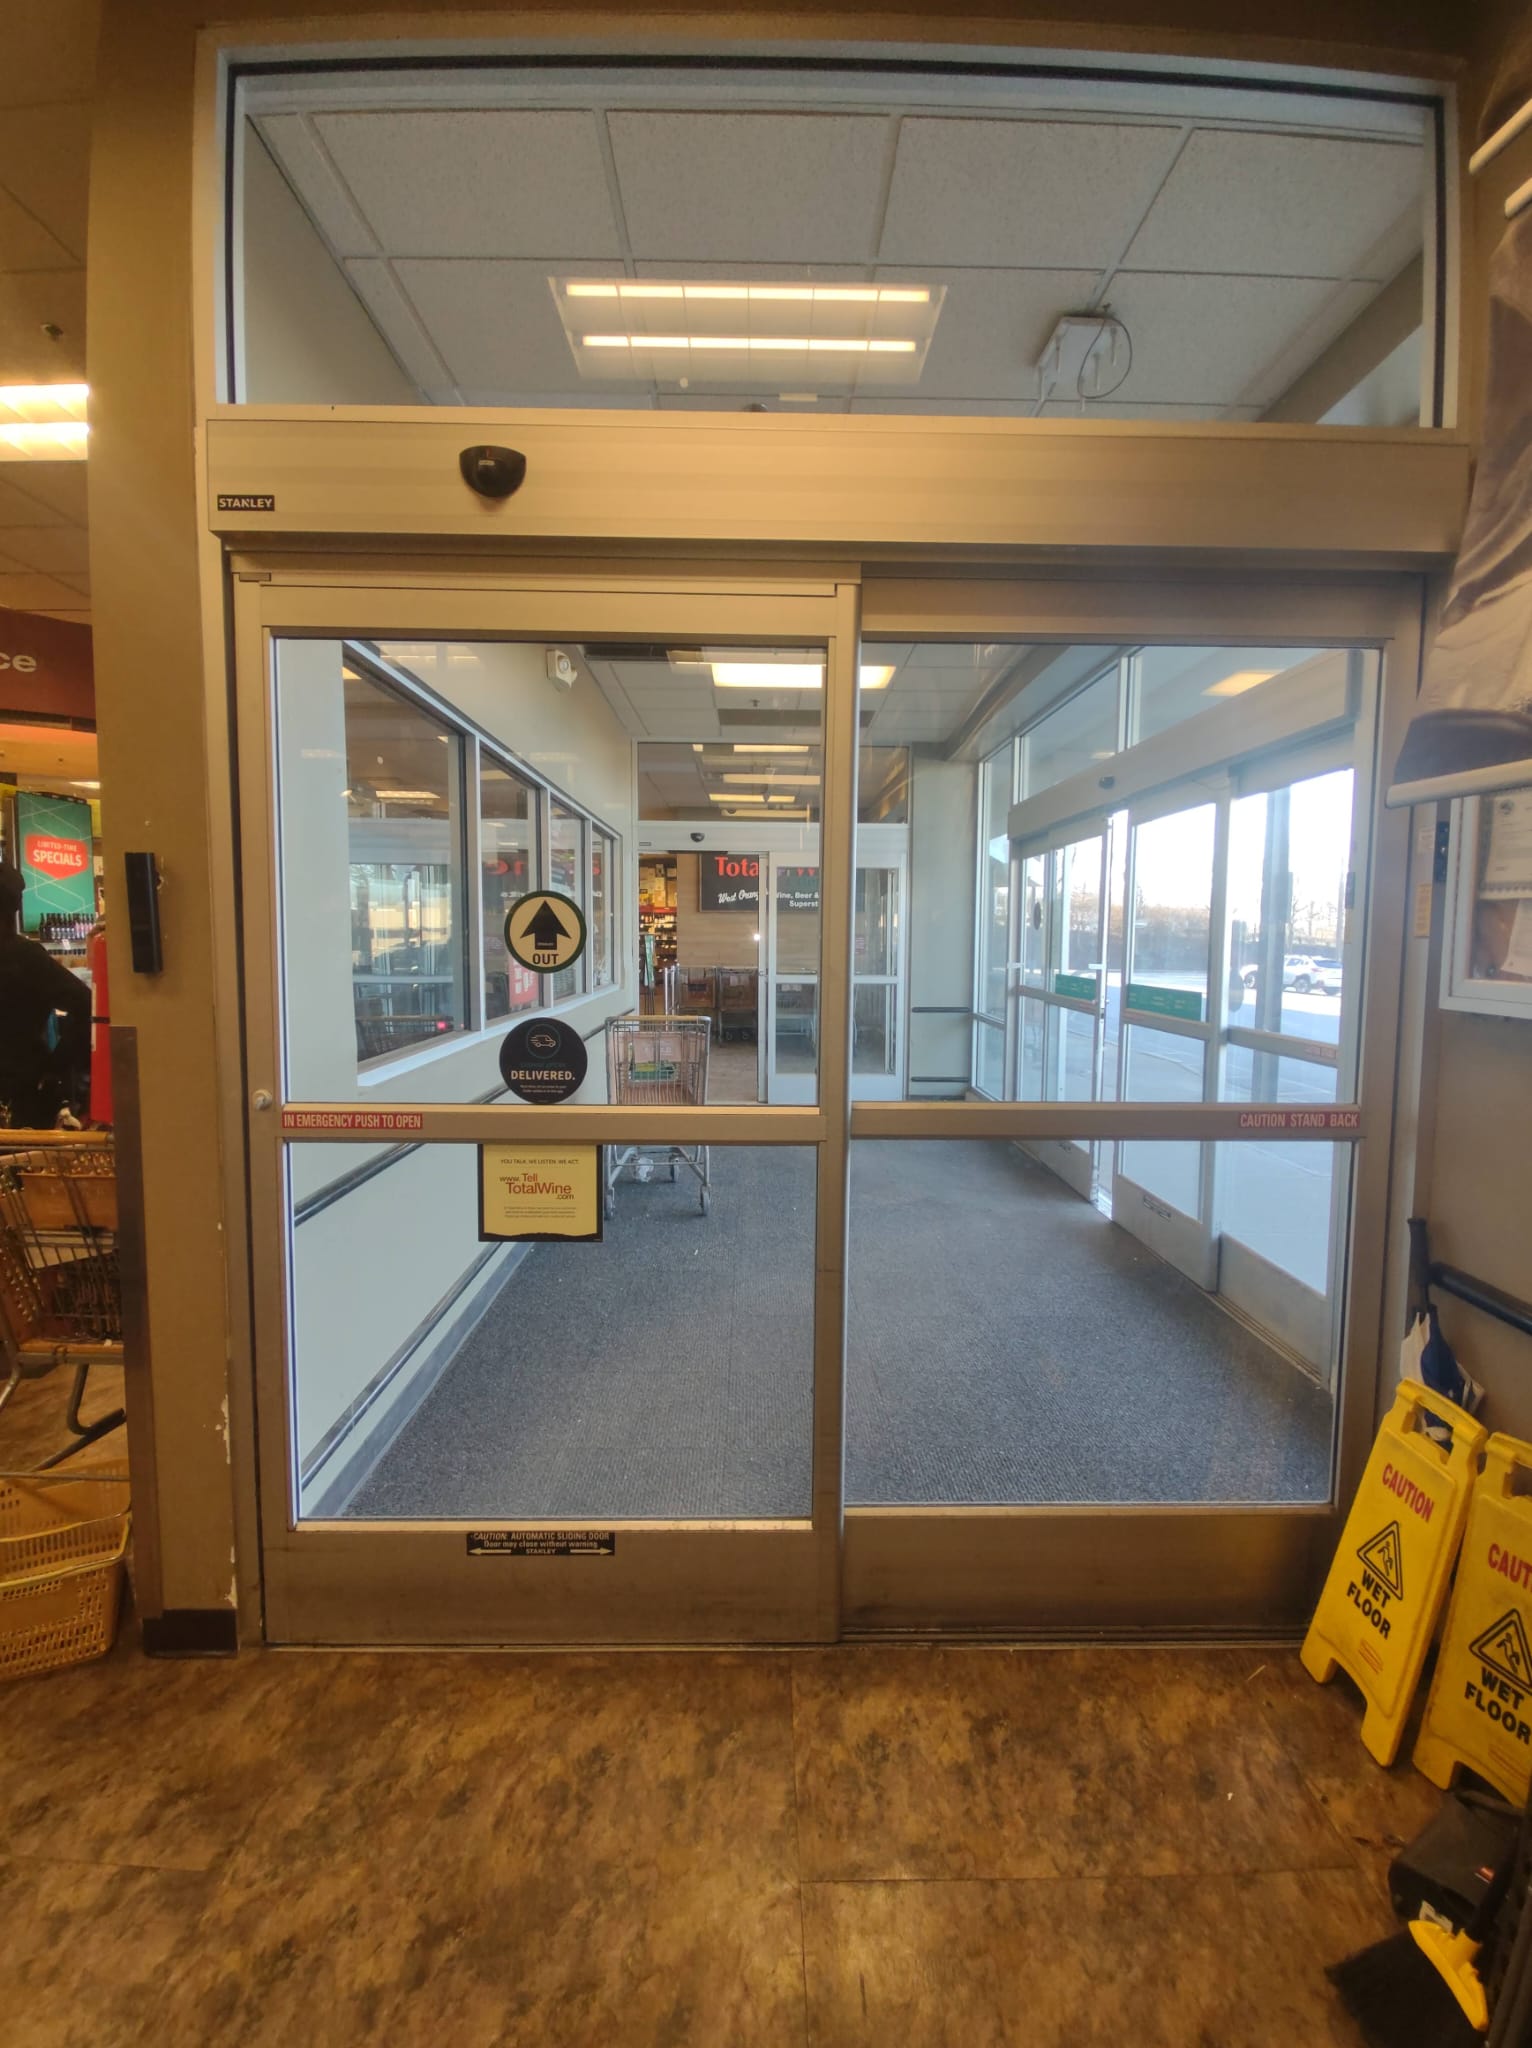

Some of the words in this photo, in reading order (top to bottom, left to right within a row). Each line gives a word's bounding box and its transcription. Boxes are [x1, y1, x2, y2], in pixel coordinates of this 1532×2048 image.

[218, 497, 273, 509] STANLEY
[33, 849, 82, 867] SPECIALS
[714, 855, 760, 877] Tota
[789, 900, 819, 908] Superst
[532, 953, 559, 965] OUT
[511, 1070, 576, 1081] DELIVERED.
[284, 1114, 294, 1127] IN
[297, 1114, 351, 1128] EMERGENCY
[354, 1114, 380, 1128] PUSH
[382, 1114, 393, 1128] TO
[396, 1115, 421, 1128] OPEN
[1240, 1112, 1286, 1128] CAUTION
[1290, 1112, 1325, 1128] STAND
[1330, 1112, 1358, 1128] BACK
[521, 1173, 538, 1182] Tell
[505, 1181, 572, 1195] TotalWine
[1381, 1463, 1435, 1523] CAUTION
[510, 1532, 556, 1540] AUTOMATIC
[557, 1532, 587, 1540] SLIDING
[588, 1532, 610, 1540] DOOR
[483, 1540, 501, 1548] Door
[502, 1541, 517, 1549] may
[540, 1540, 567, 1548] without
[568, 1540, 598, 1549] warning
[1487, 1543, 1532, 1594] CAUT
[1361, 1568, 1391, 1609] WET
[1346, 1581, 1392, 1640] FLOOR
[1480, 1665, 1525, 1711] WET
[1463, 1680, 1532, 1746] FLOOR
